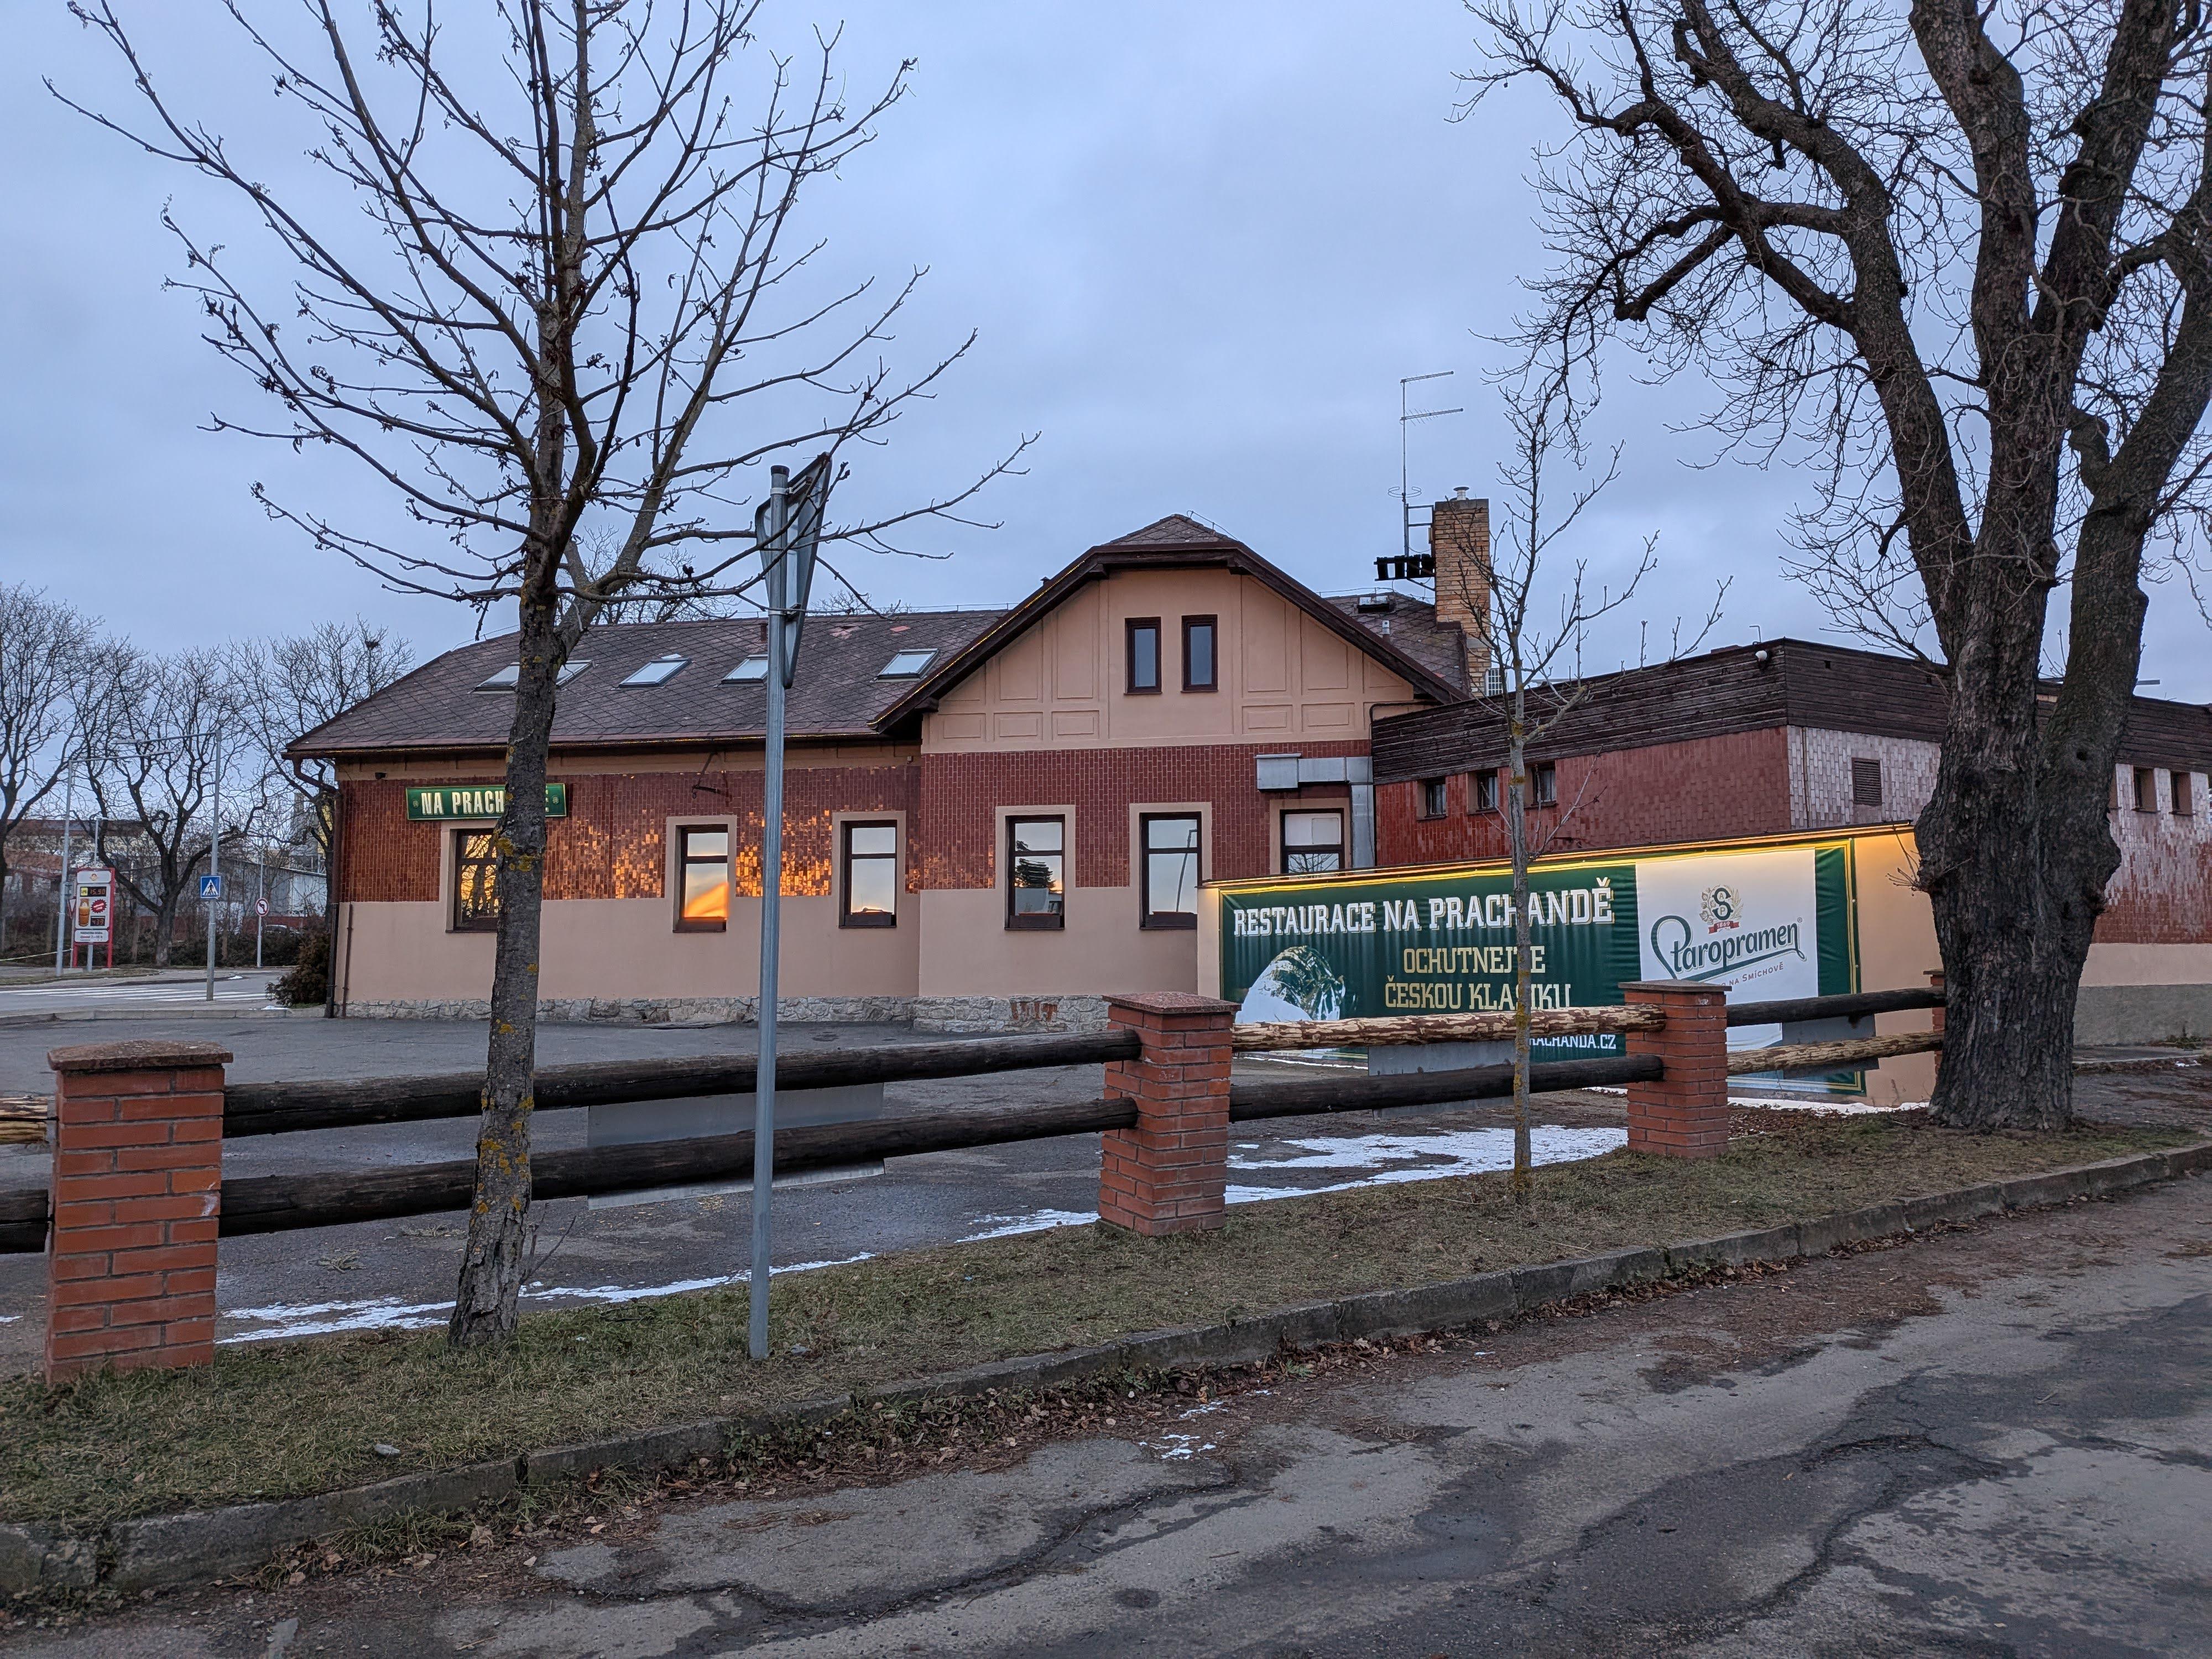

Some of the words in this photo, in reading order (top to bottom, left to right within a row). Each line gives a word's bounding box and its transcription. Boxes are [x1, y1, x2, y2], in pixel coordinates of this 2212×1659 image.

[421, 792, 444, 815] NA
[1234, 902, 1376, 937] RESTAURACE
[1383, 899, 1422, 932] NA
[1404, 946, 1546, 973] OCHUTNEJE
[1651, 915, 1806, 982] Staropramen
[1385, 975, 1462, 1009] ČESKOU
[1469, 983, 1571, 1010] KLAIKU
[1729, 978, 1740, 986] NA
